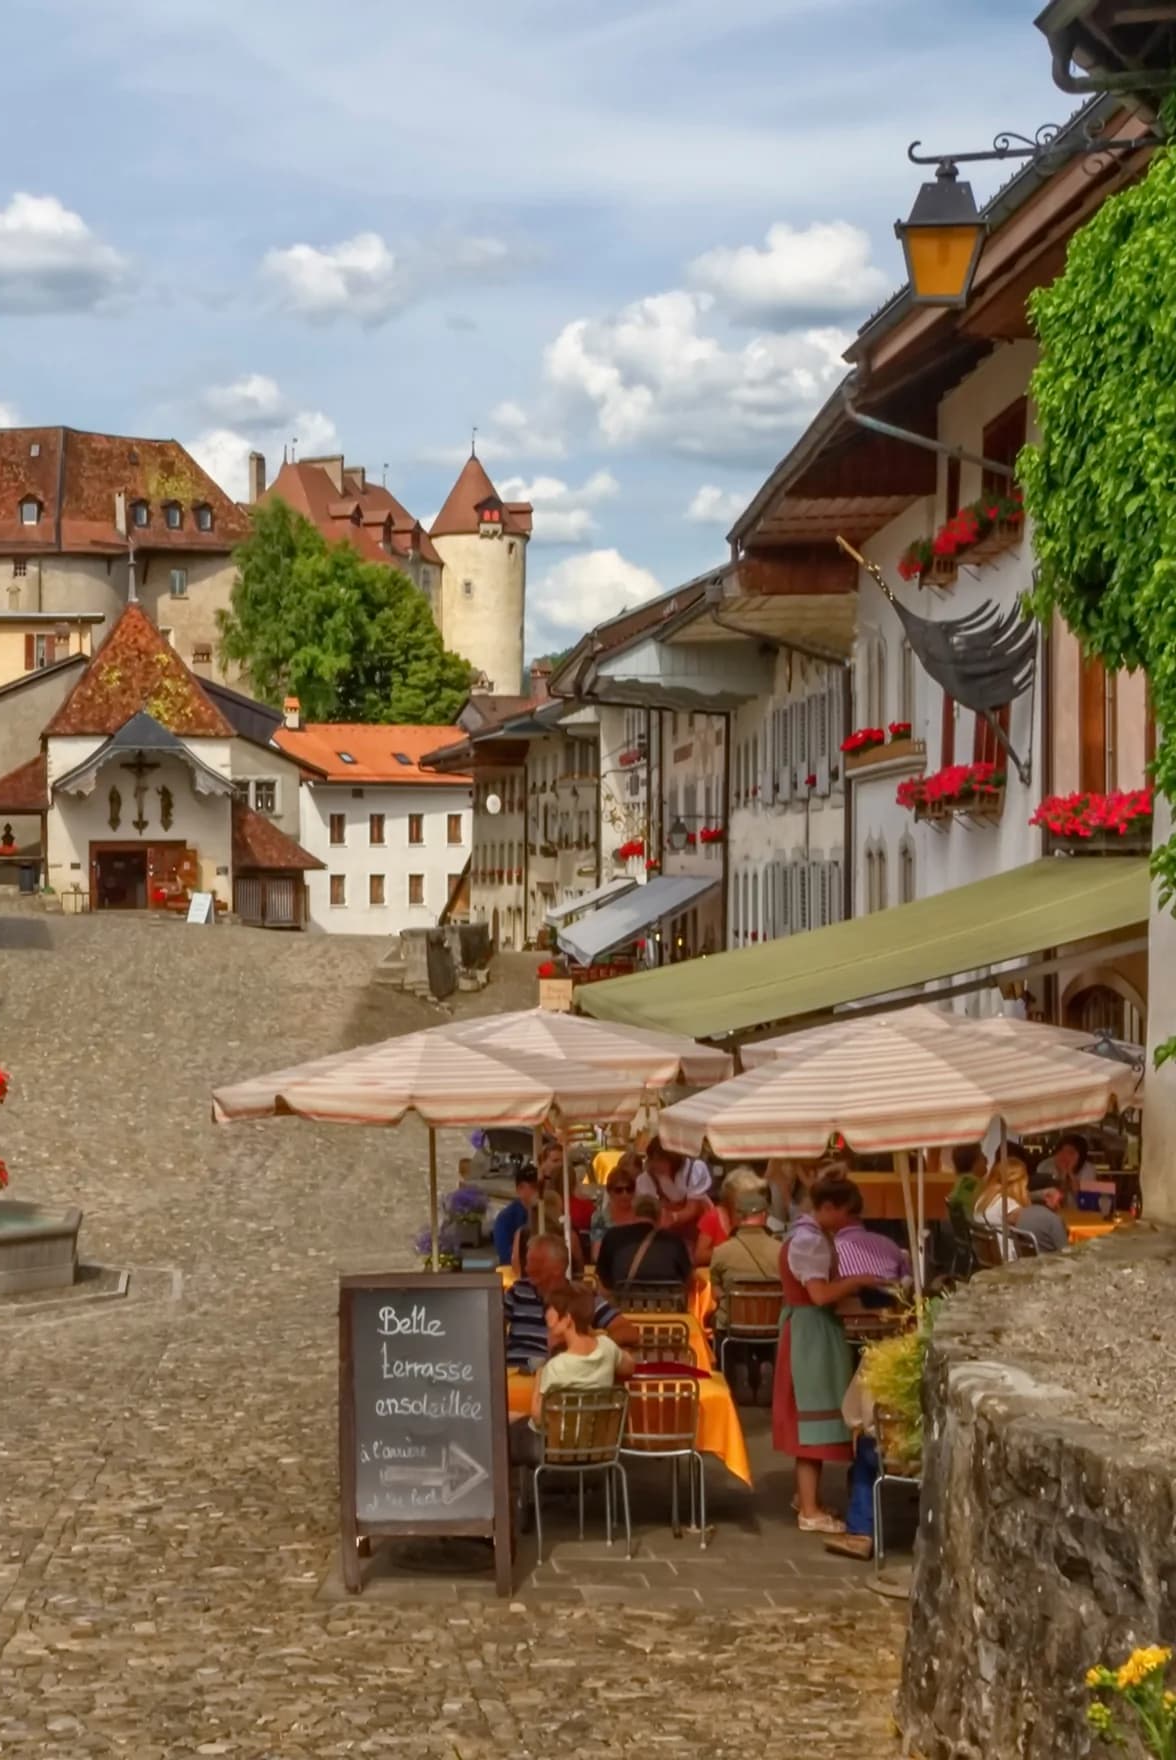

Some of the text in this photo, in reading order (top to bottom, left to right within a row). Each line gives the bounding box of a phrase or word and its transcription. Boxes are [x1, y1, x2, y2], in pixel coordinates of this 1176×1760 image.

[377, 1304, 446, 1336] Belle
[380, 1341, 474, 1382] terrasse
[376, 1390, 483, 1420] ensoleillée
